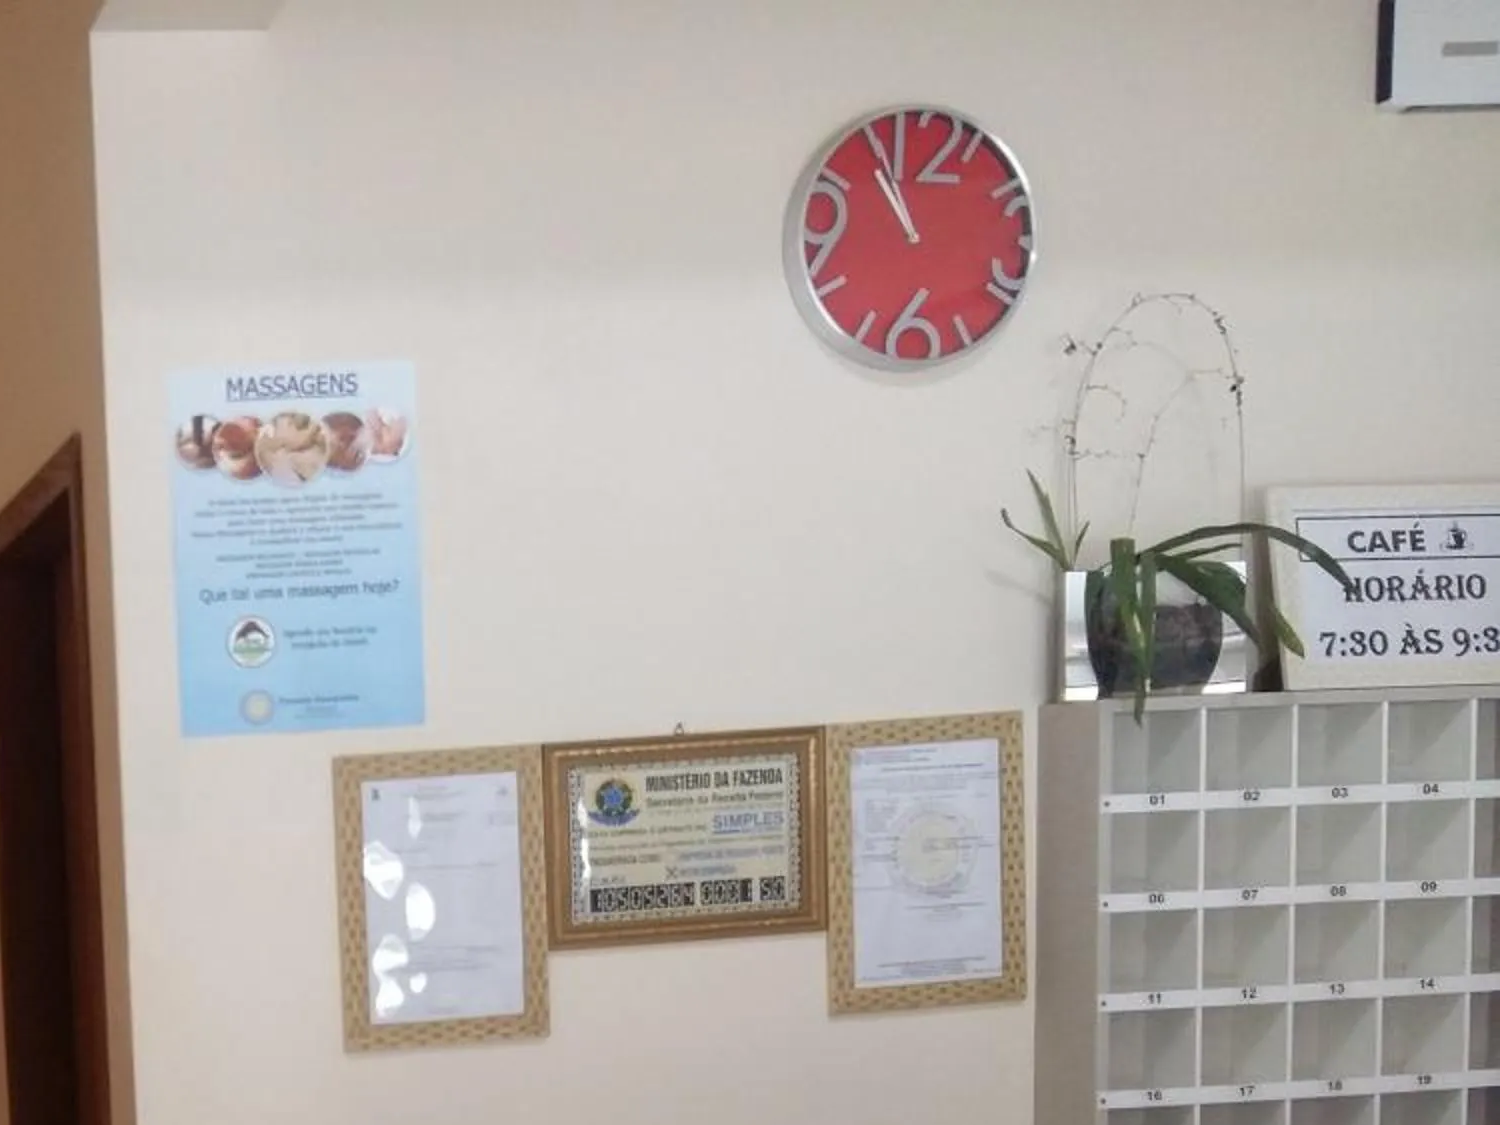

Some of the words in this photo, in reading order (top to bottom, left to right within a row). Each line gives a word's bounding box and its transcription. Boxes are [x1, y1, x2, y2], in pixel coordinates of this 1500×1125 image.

[226, 373, 359, 398] MASSAGENS
[1347, 521, 1426, 553] CAFÉ
[200, 588, 227, 605] Que
[287, 583, 358, 599] massagem
[1343, 568, 1487, 602] HORÁRIO
[1319, 629, 1389, 657] 7:30
[1399, 622, 1444, 656] ÀS
[645, 773, 711, 792] MINISTÉRIO
[713, 771, 729, 788] DA
[732, 767, 783, 787] FAZENDA
[1422, 783, 1439, 795] 04
[1149, 794, 1165, 805] 01
[1243, 791, 1260, 801] 02
[1331, 787, 1348, 798] 03
[712, 810, 784, 831] SIMPLES
[1419, 978, 1435, 989] 14
[1148, 992, 1162, 1004] 11
